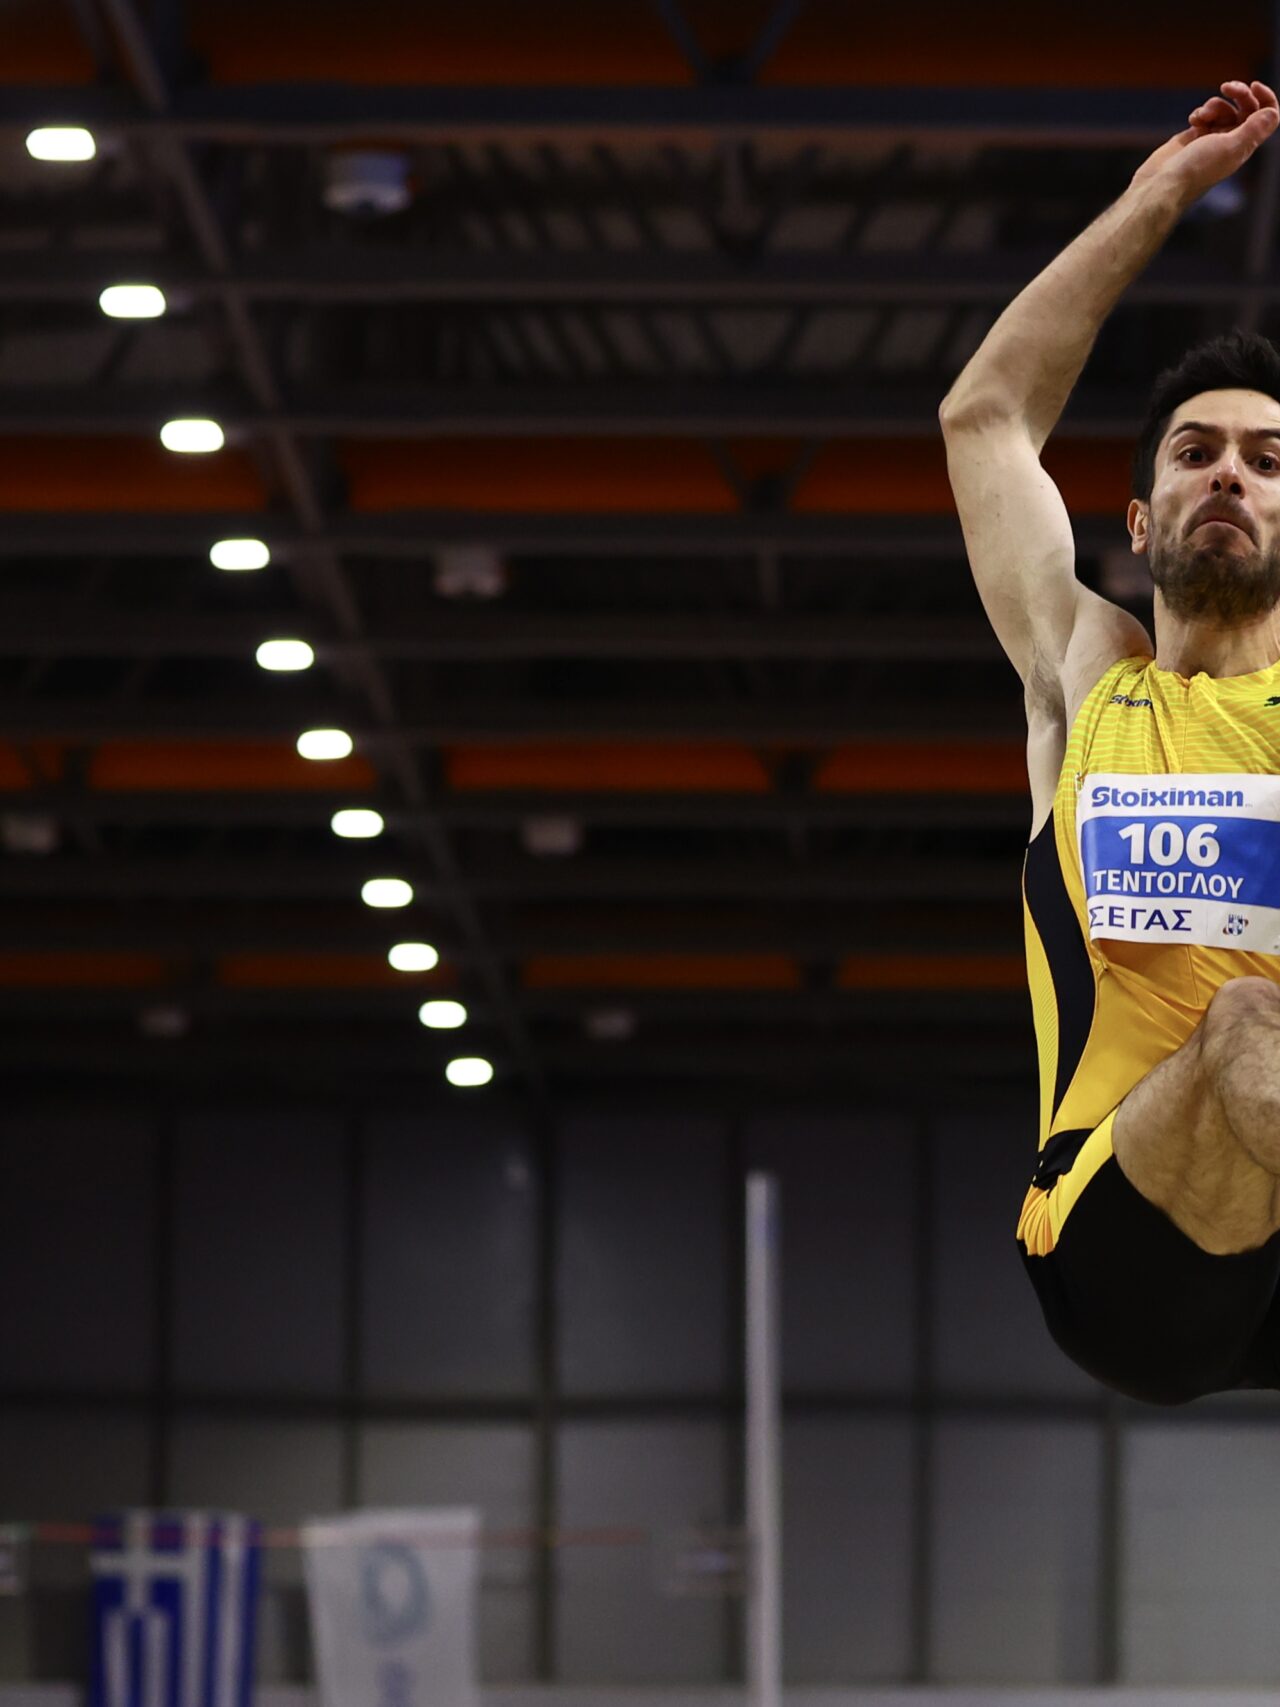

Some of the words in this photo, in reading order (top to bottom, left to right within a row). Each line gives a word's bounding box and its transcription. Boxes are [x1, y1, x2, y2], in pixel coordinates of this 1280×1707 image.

[1091, 786, 1244, 808] Stoiximan
[1118, 821, 1220, 868] 106
[1092, 869, 1244, 899] ΤΕΝΤΟΓΛΟΥ
[1088, 905, 1192, 932] ΣΕΓΑΣ
